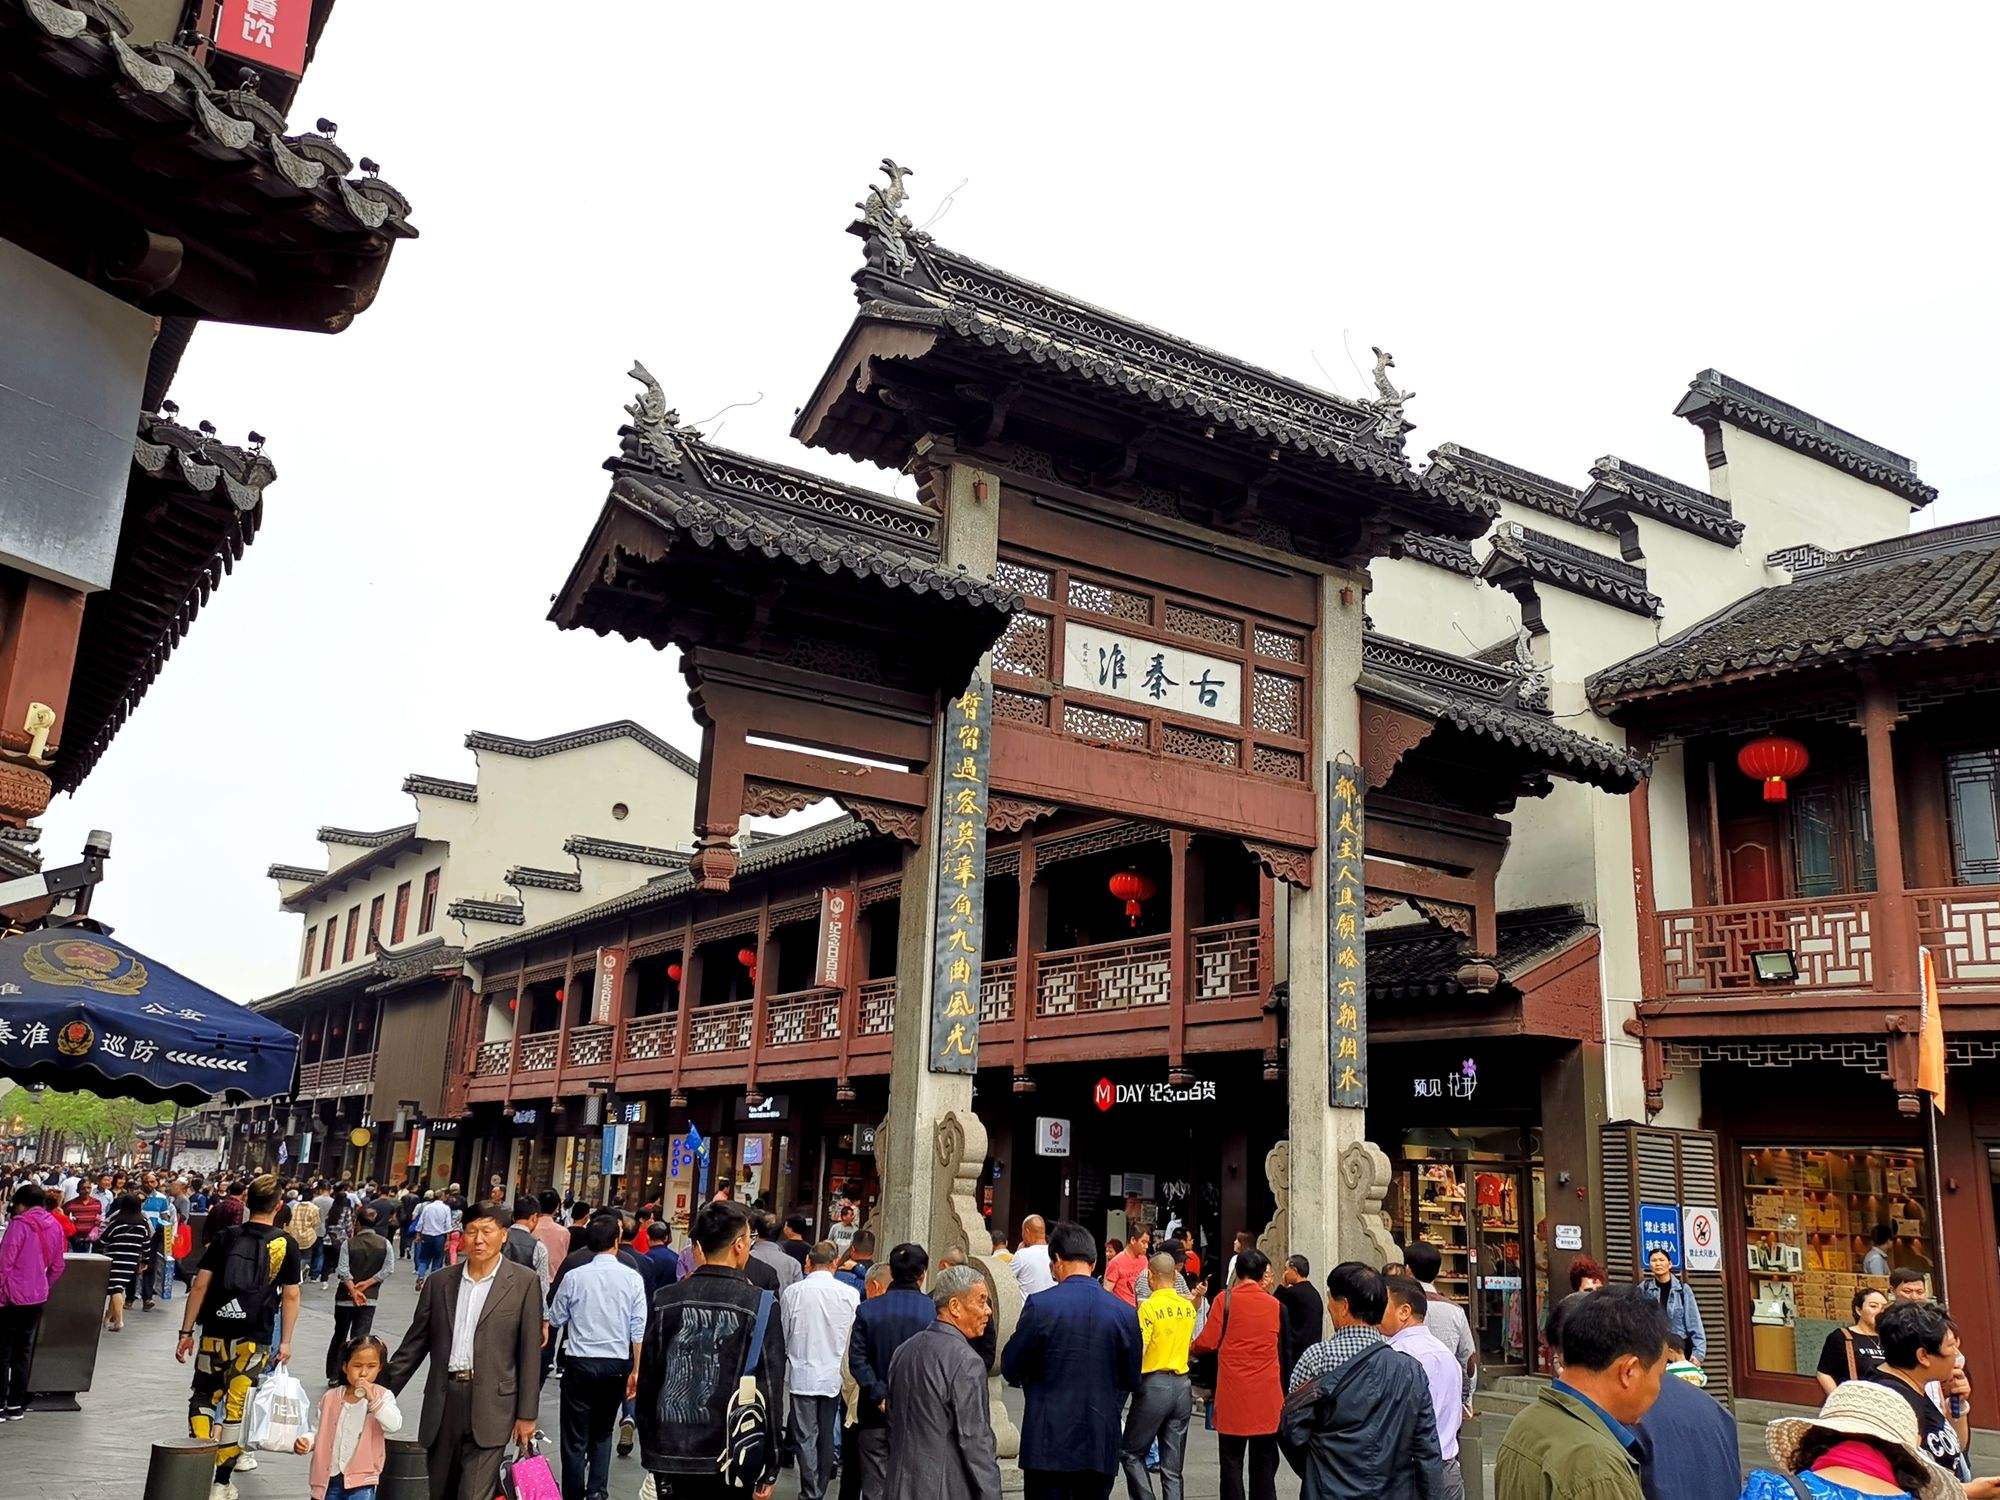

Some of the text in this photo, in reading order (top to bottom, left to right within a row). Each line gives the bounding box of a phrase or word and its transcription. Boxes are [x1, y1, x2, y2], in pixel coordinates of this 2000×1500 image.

[1099, 643, 1225, 707] 古秦淮
[141, 1003, 206, 1022] 公安
[100, 1033, 159, 1063] 巡防
[1116, 1084, 1145, 1103] DAY
